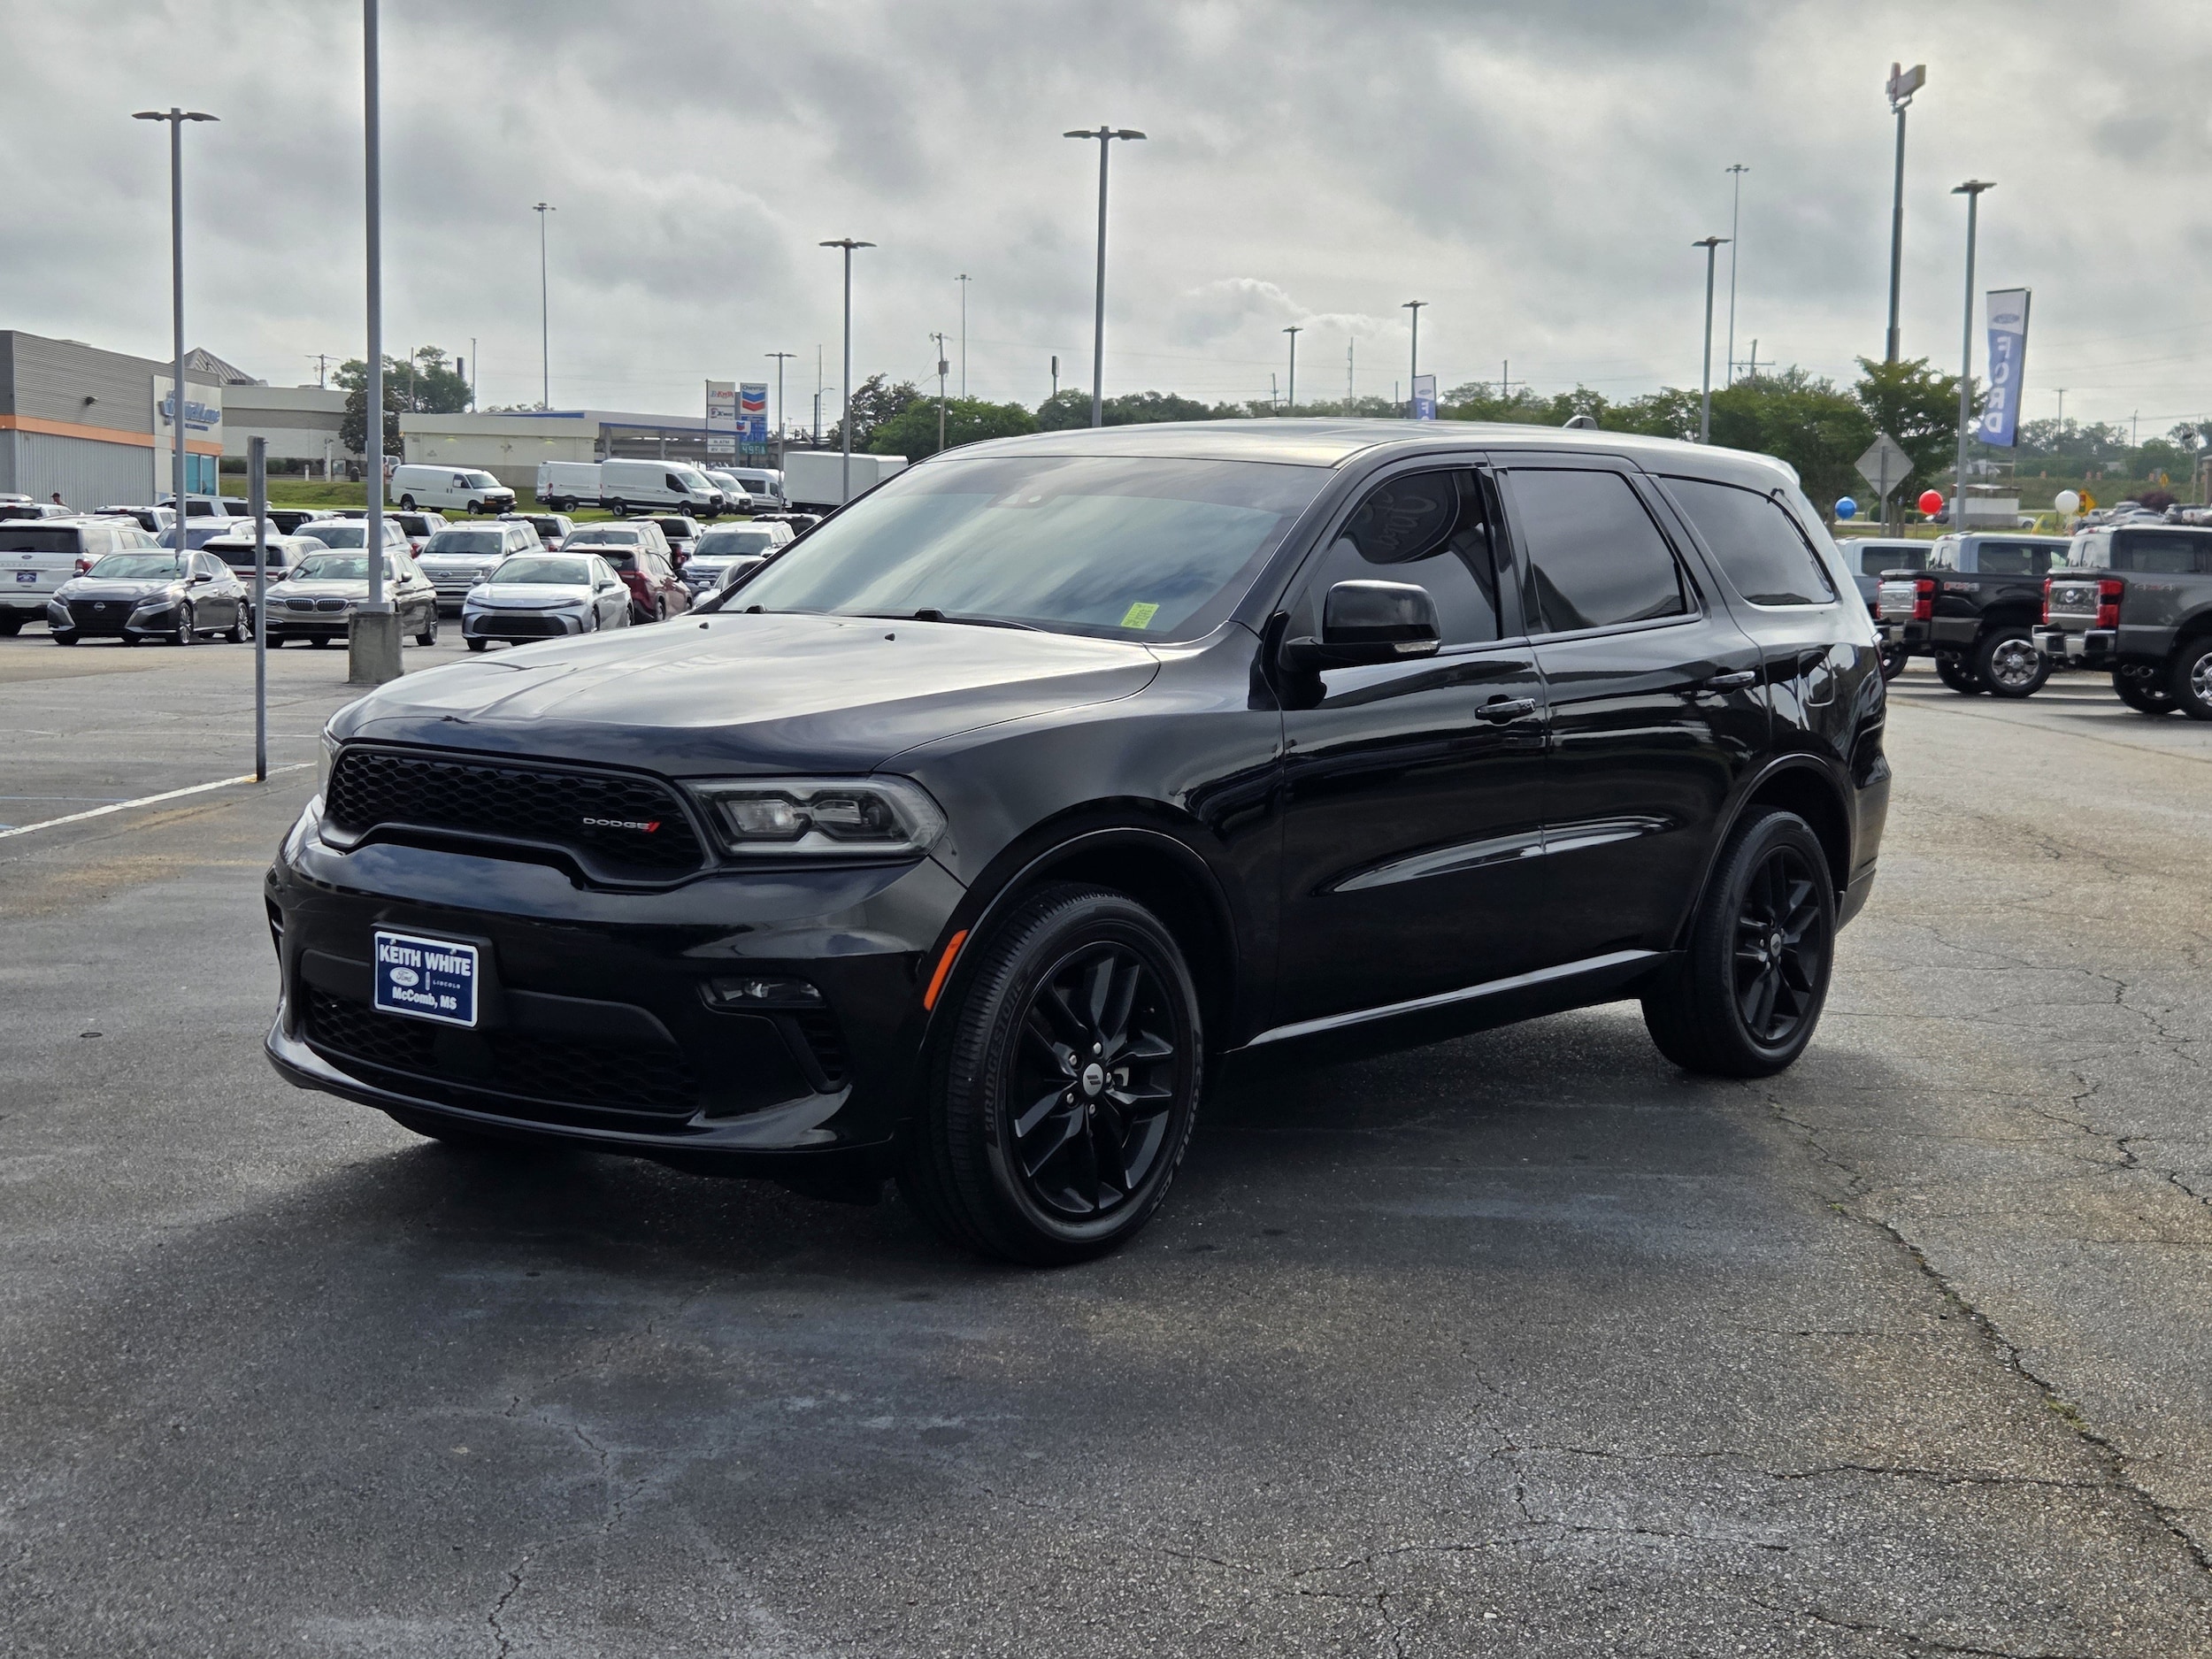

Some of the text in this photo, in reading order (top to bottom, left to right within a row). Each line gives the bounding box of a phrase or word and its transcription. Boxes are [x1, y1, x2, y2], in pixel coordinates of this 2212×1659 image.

[583, 818, 649, 830] DODGE
[380, 944, 471, 976] KEITH WHITE
[396, 970, 413, 983] Ford
[392, 987, 457, 1010] McComb, MS
[985, 979, 1025, 1132] BRIDGESTONE
